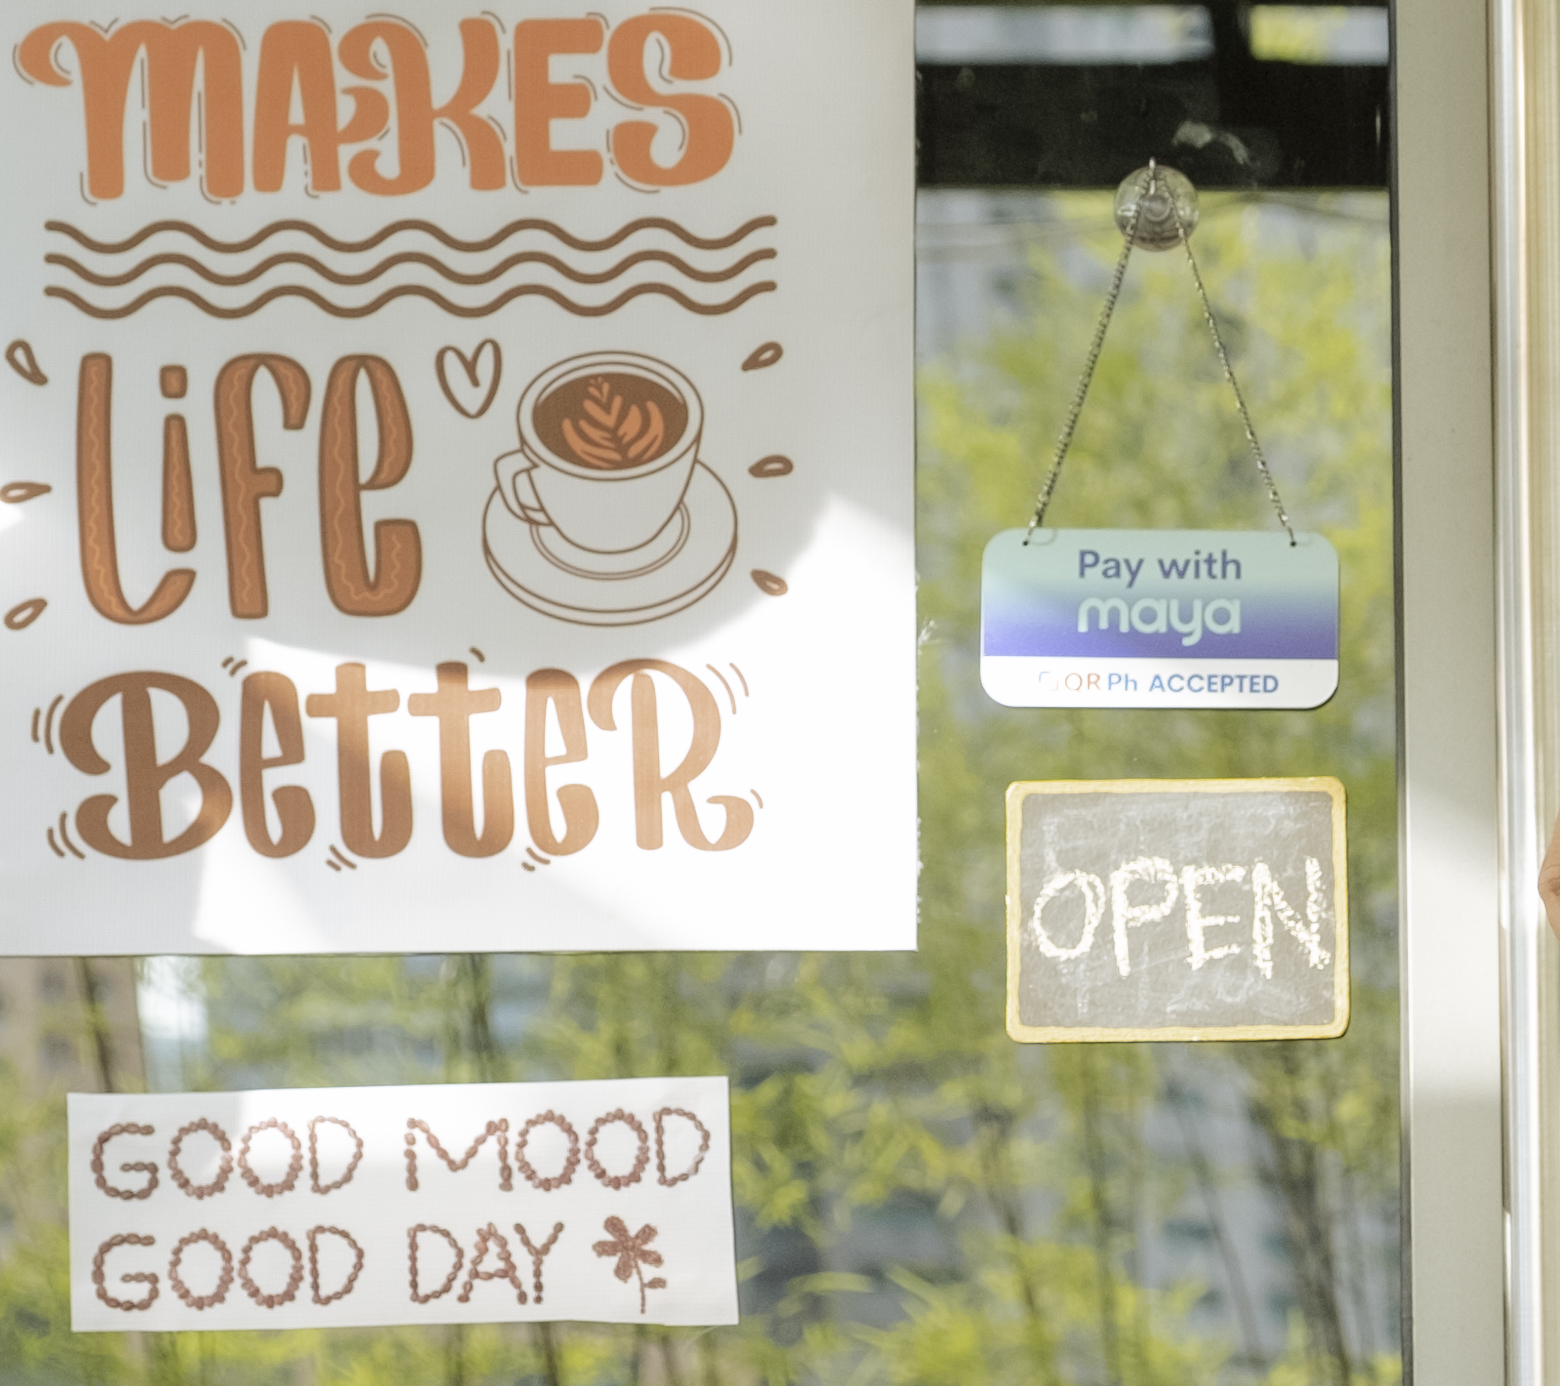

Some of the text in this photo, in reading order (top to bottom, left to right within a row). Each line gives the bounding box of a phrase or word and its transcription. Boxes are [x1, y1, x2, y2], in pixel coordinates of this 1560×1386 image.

[17, 10, 736, 200] MAKES
[1078, 549, 1242, 588] Pay with
[1077, 597, 1241, 647] maya
[1107, 673, 1138, 692] Ph
[1148, 674, 1279, 694] ACCEPTED
[1032, 855, 1331, 979] OPEN
[91, 1107, 710, 1200] GOOD MOOD
[91, 1222, 565, 1311] GOOD DAY
